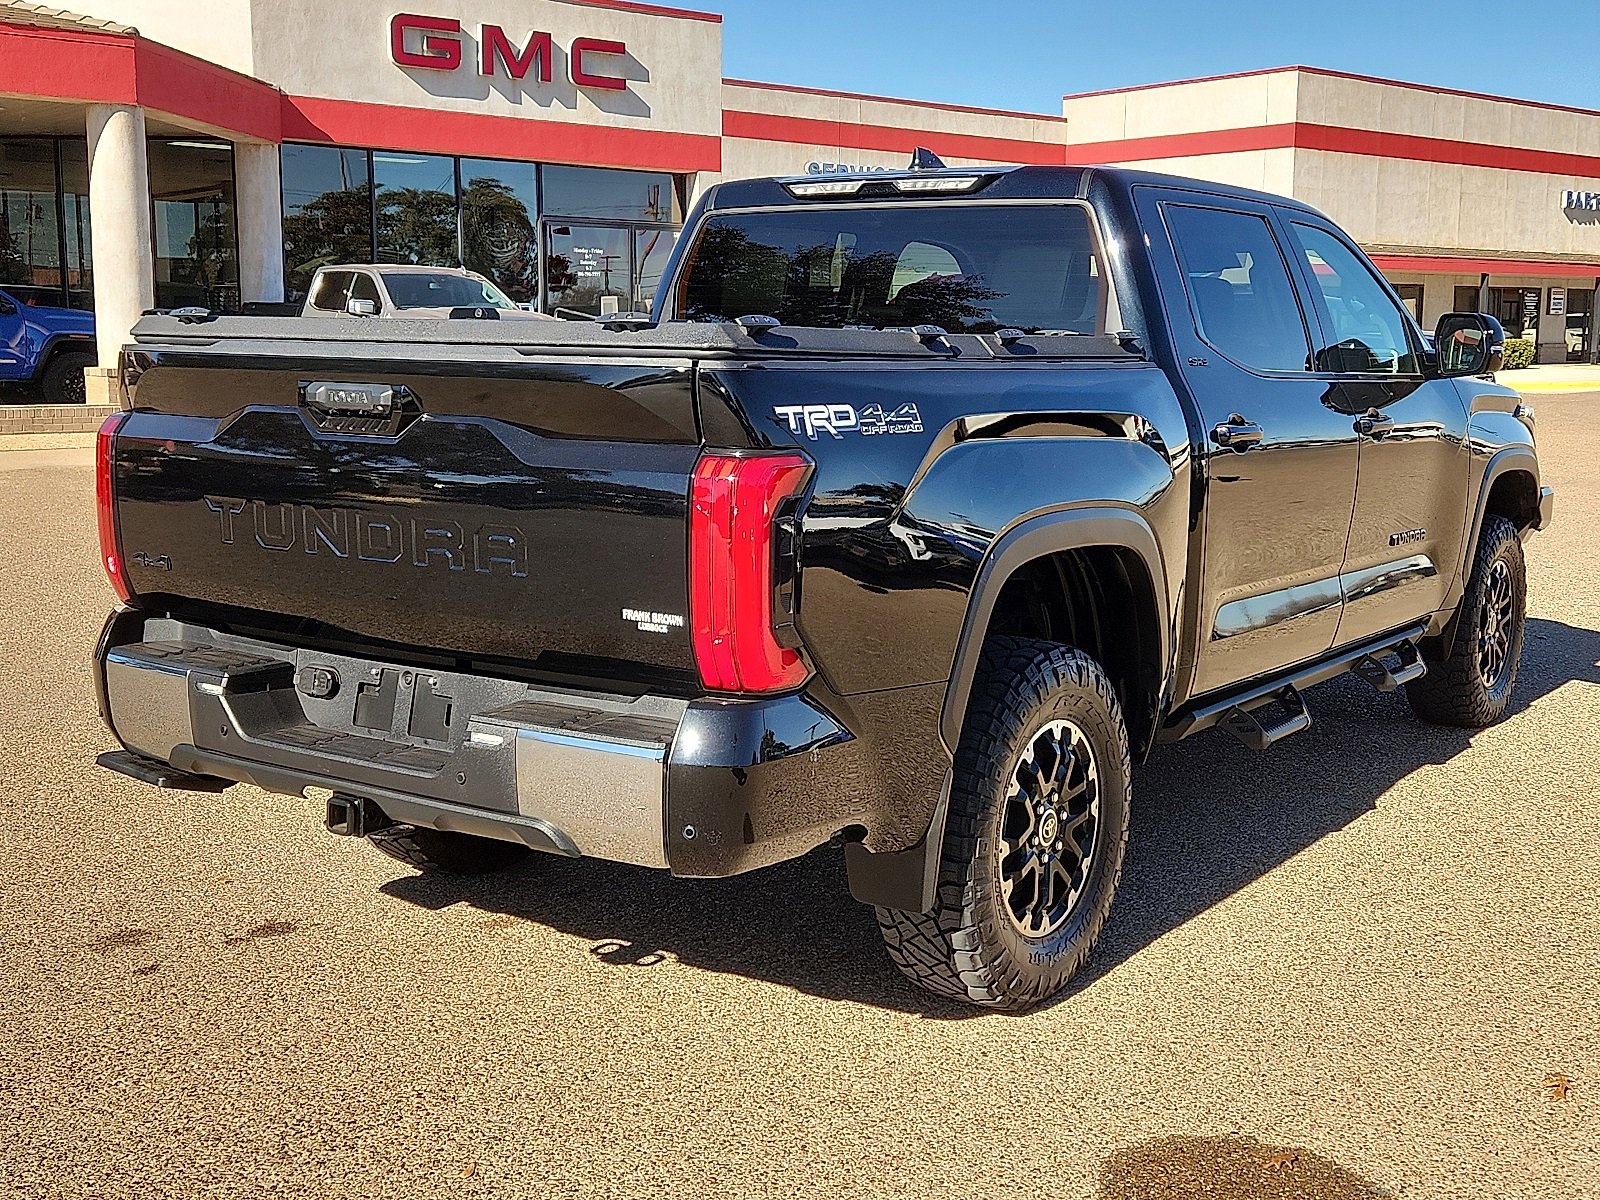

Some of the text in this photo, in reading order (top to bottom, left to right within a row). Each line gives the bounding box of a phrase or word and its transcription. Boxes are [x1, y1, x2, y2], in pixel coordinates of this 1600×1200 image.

[388, 12, 627, 91] GMC
[328, 391, 368, 404] TOYOTA
[774, 403, 860, 440] TRD
[203, 495, 530, 578] TUNDRA
[1394, 528, 1427, 545] TUNDRA
[622, 608, 683, 627] FRANK BROWN
